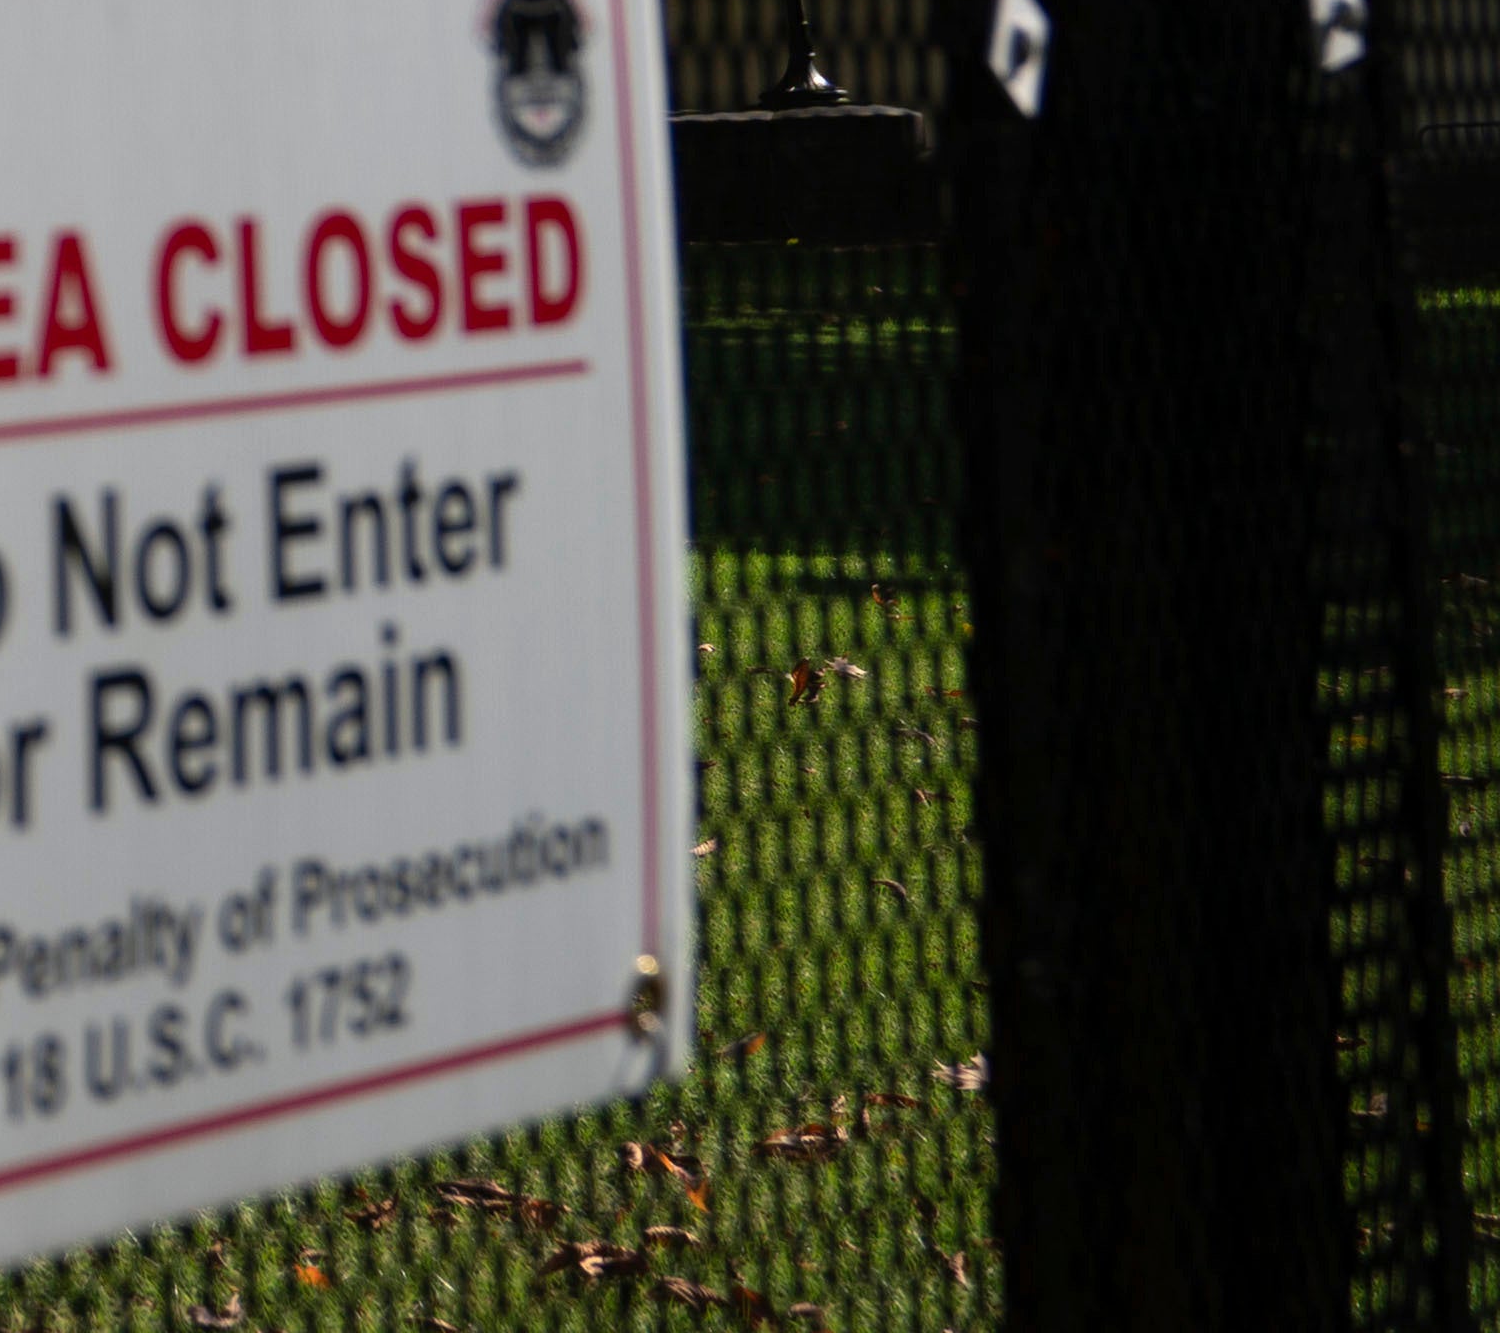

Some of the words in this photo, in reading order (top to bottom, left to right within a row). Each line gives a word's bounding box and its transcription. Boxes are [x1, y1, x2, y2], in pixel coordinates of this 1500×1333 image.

[150, 192, 587, 369] CLOSED
[51, 487, 235, 638] Not
[265, 460, 520, 606] Enter
[87, 624, 463, 815] Remain
[217, 864, 281, 955] of
[290, 811, 610, 937] Prosecution
[0, 1037, 66, 1123] 18
[82, 989, 266, 1102] U.S.C.
[286, 952, 412, 1051] 1752
